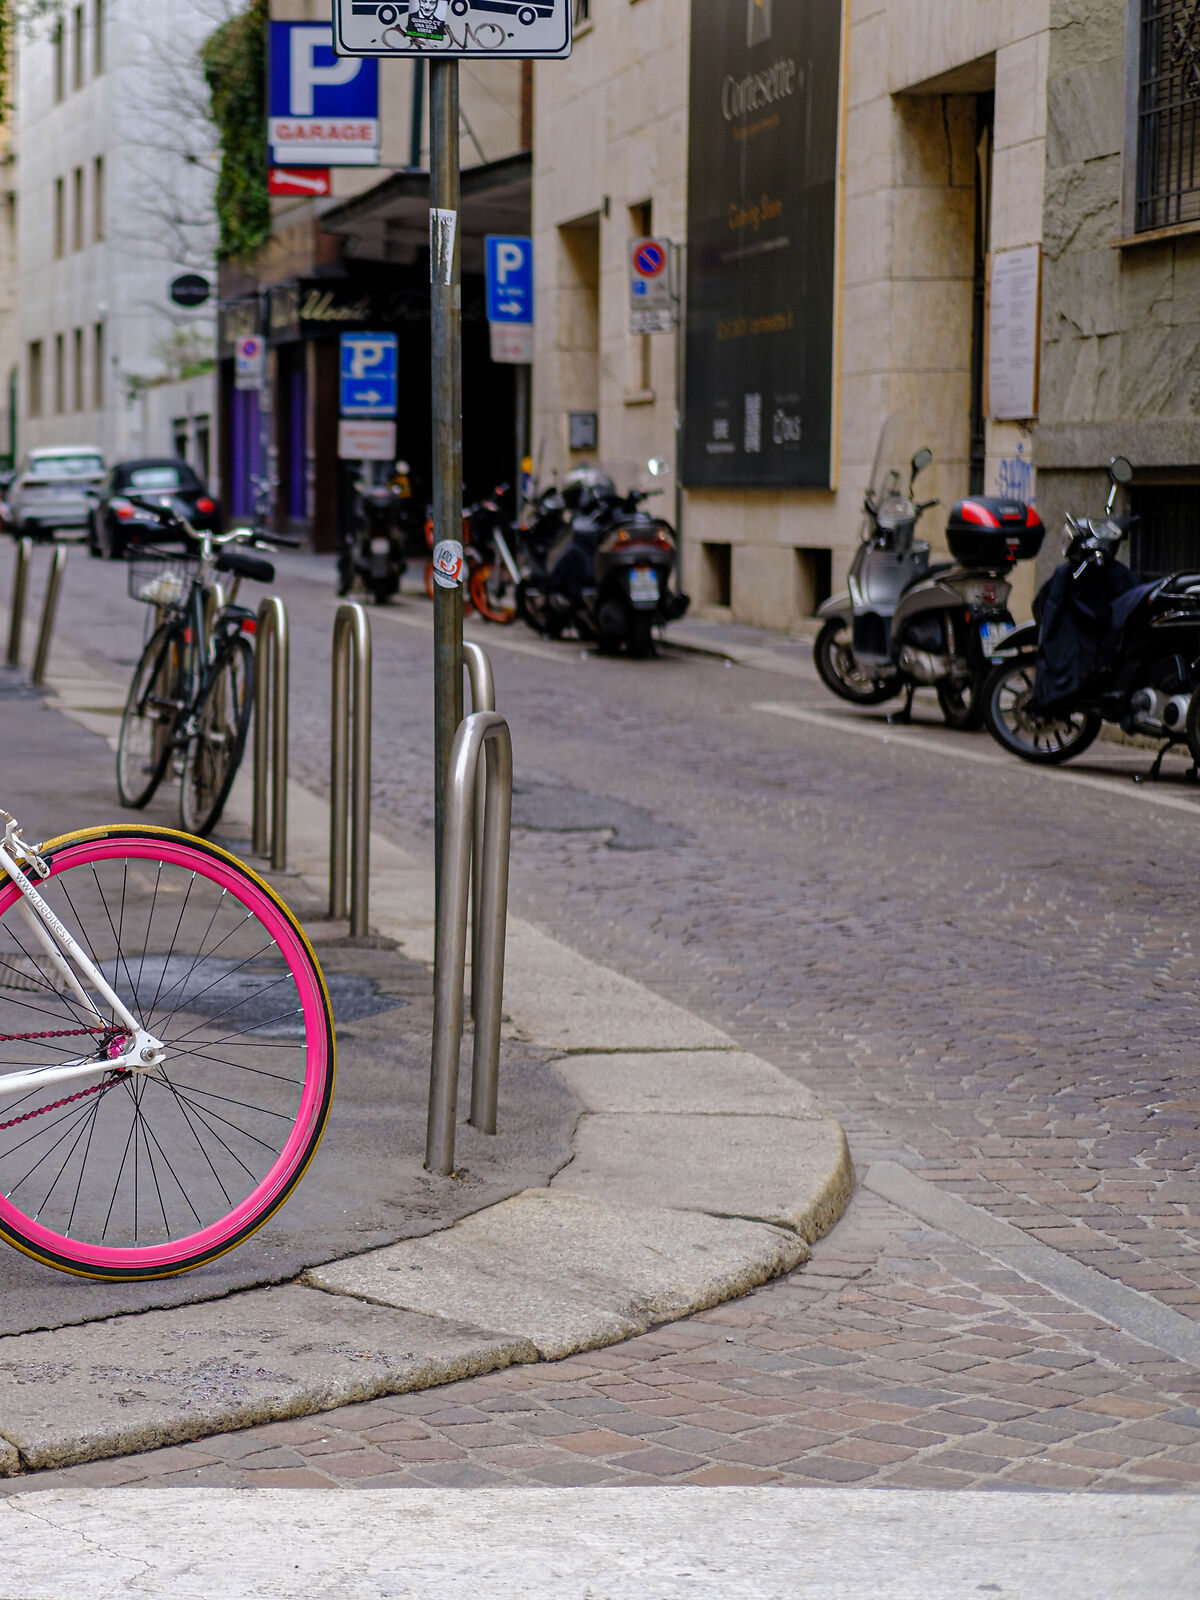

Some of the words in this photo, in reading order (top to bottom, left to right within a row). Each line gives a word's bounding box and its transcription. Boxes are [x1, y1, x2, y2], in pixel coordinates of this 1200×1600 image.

[290, 26, 362, 116] P
[275, 123, 374, 142] GARAGE
[497, 243, 524, 284] P
[351, 342, 384, 379] P
[15, 872, 75, 948] www.bebikes.it
